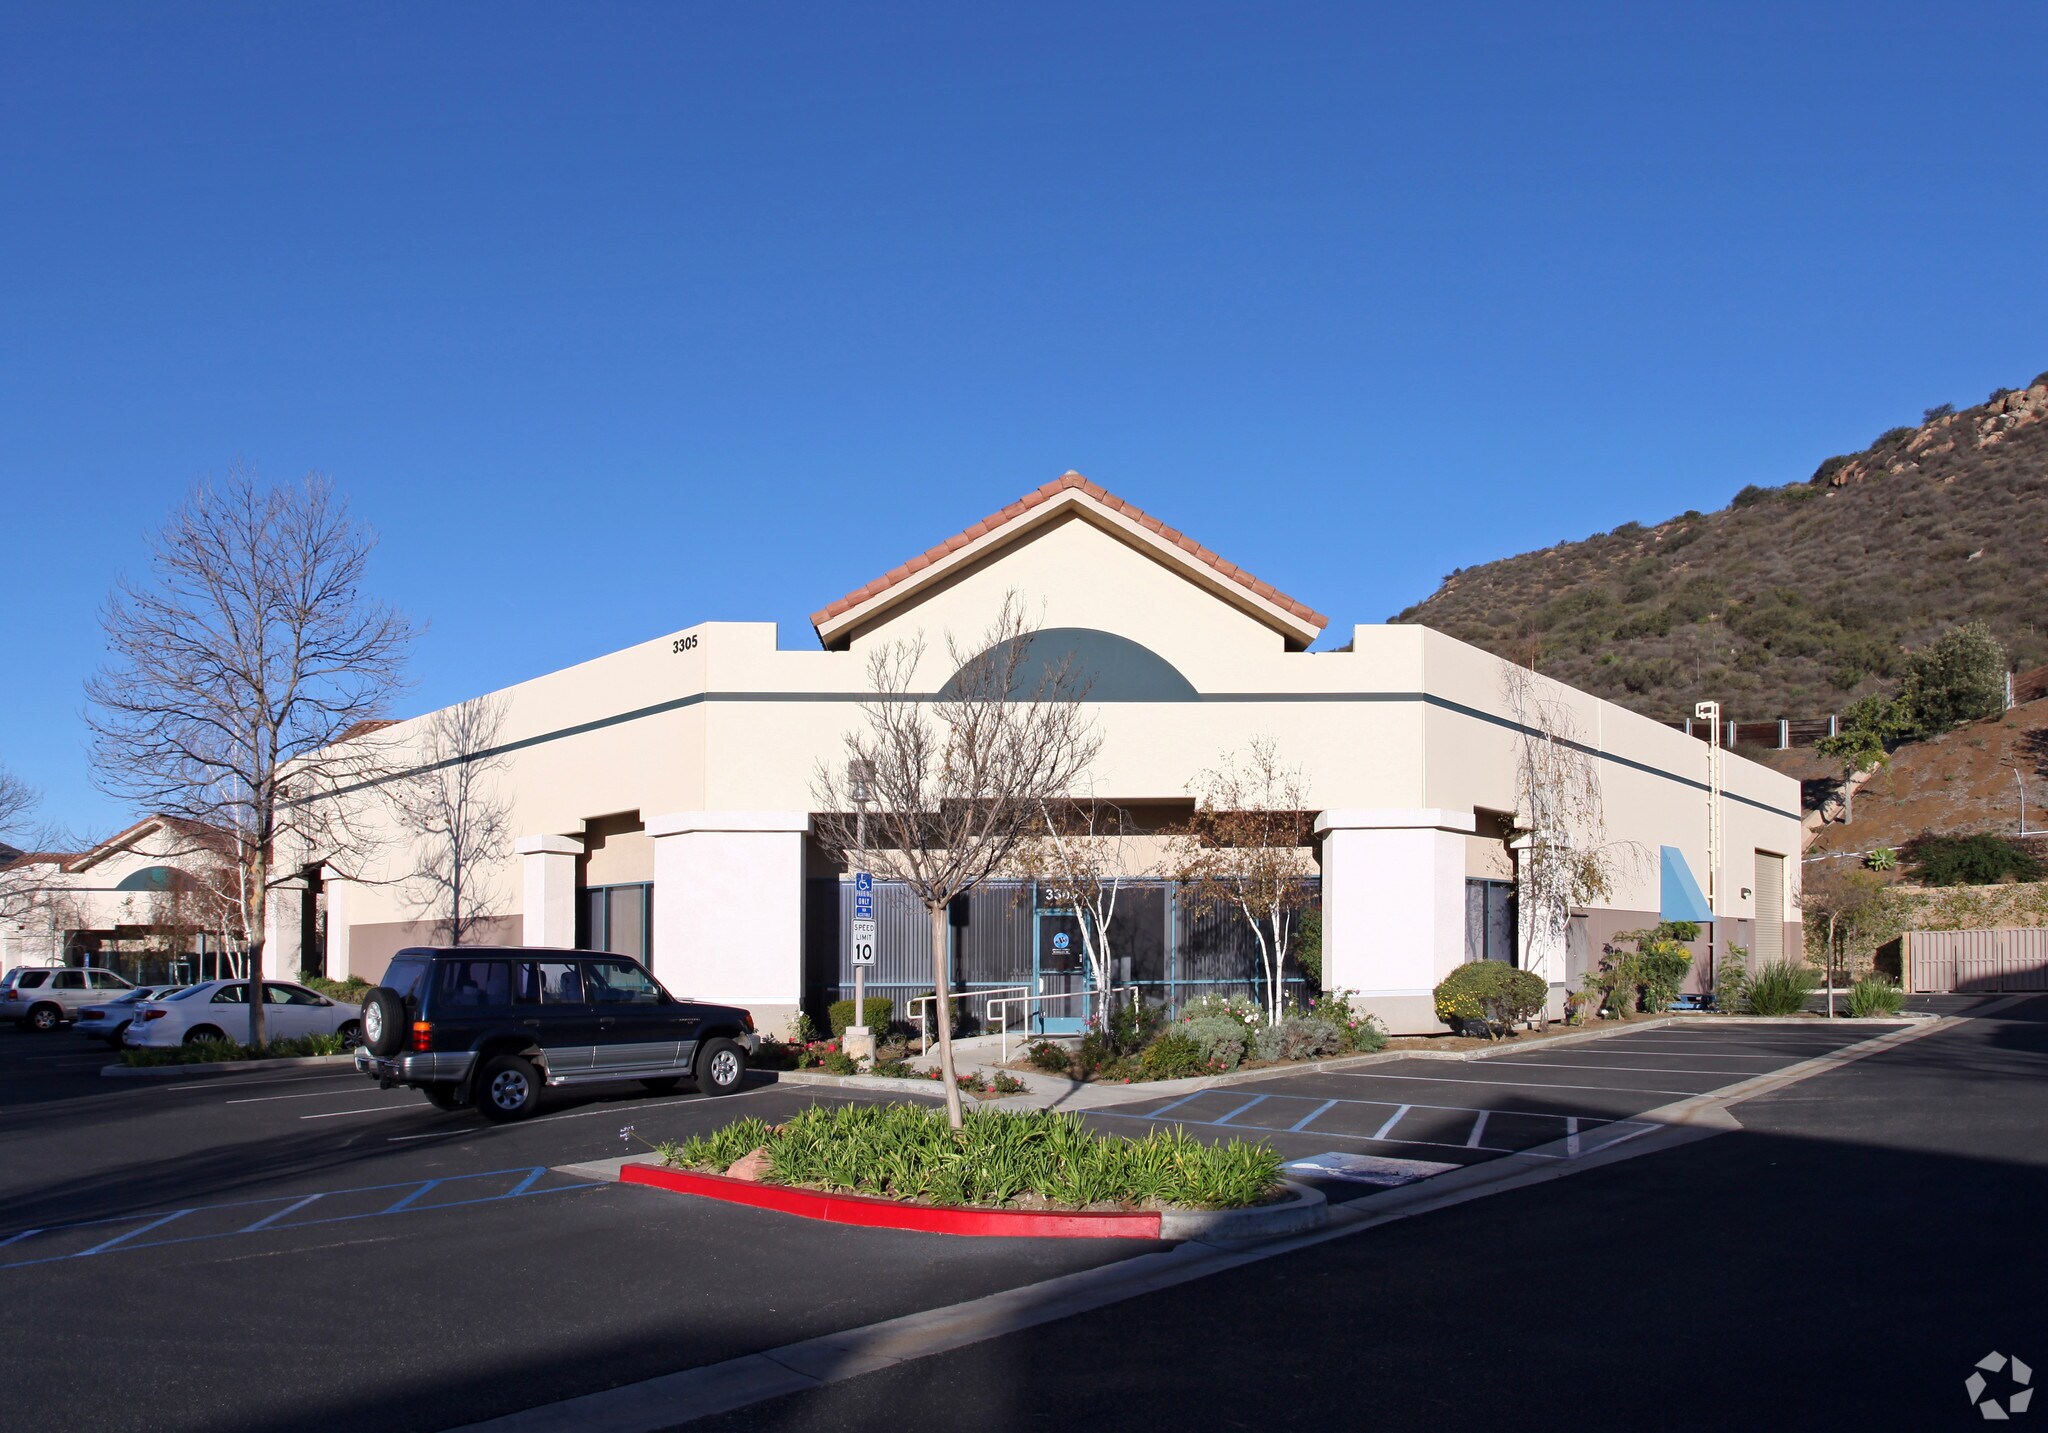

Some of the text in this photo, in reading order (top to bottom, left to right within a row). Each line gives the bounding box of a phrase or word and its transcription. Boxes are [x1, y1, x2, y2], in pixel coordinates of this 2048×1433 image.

[672, 634, 698, 654] 3305
[858, 897, 870, 905] ONLY
[856, 943, 872, 960] 10
